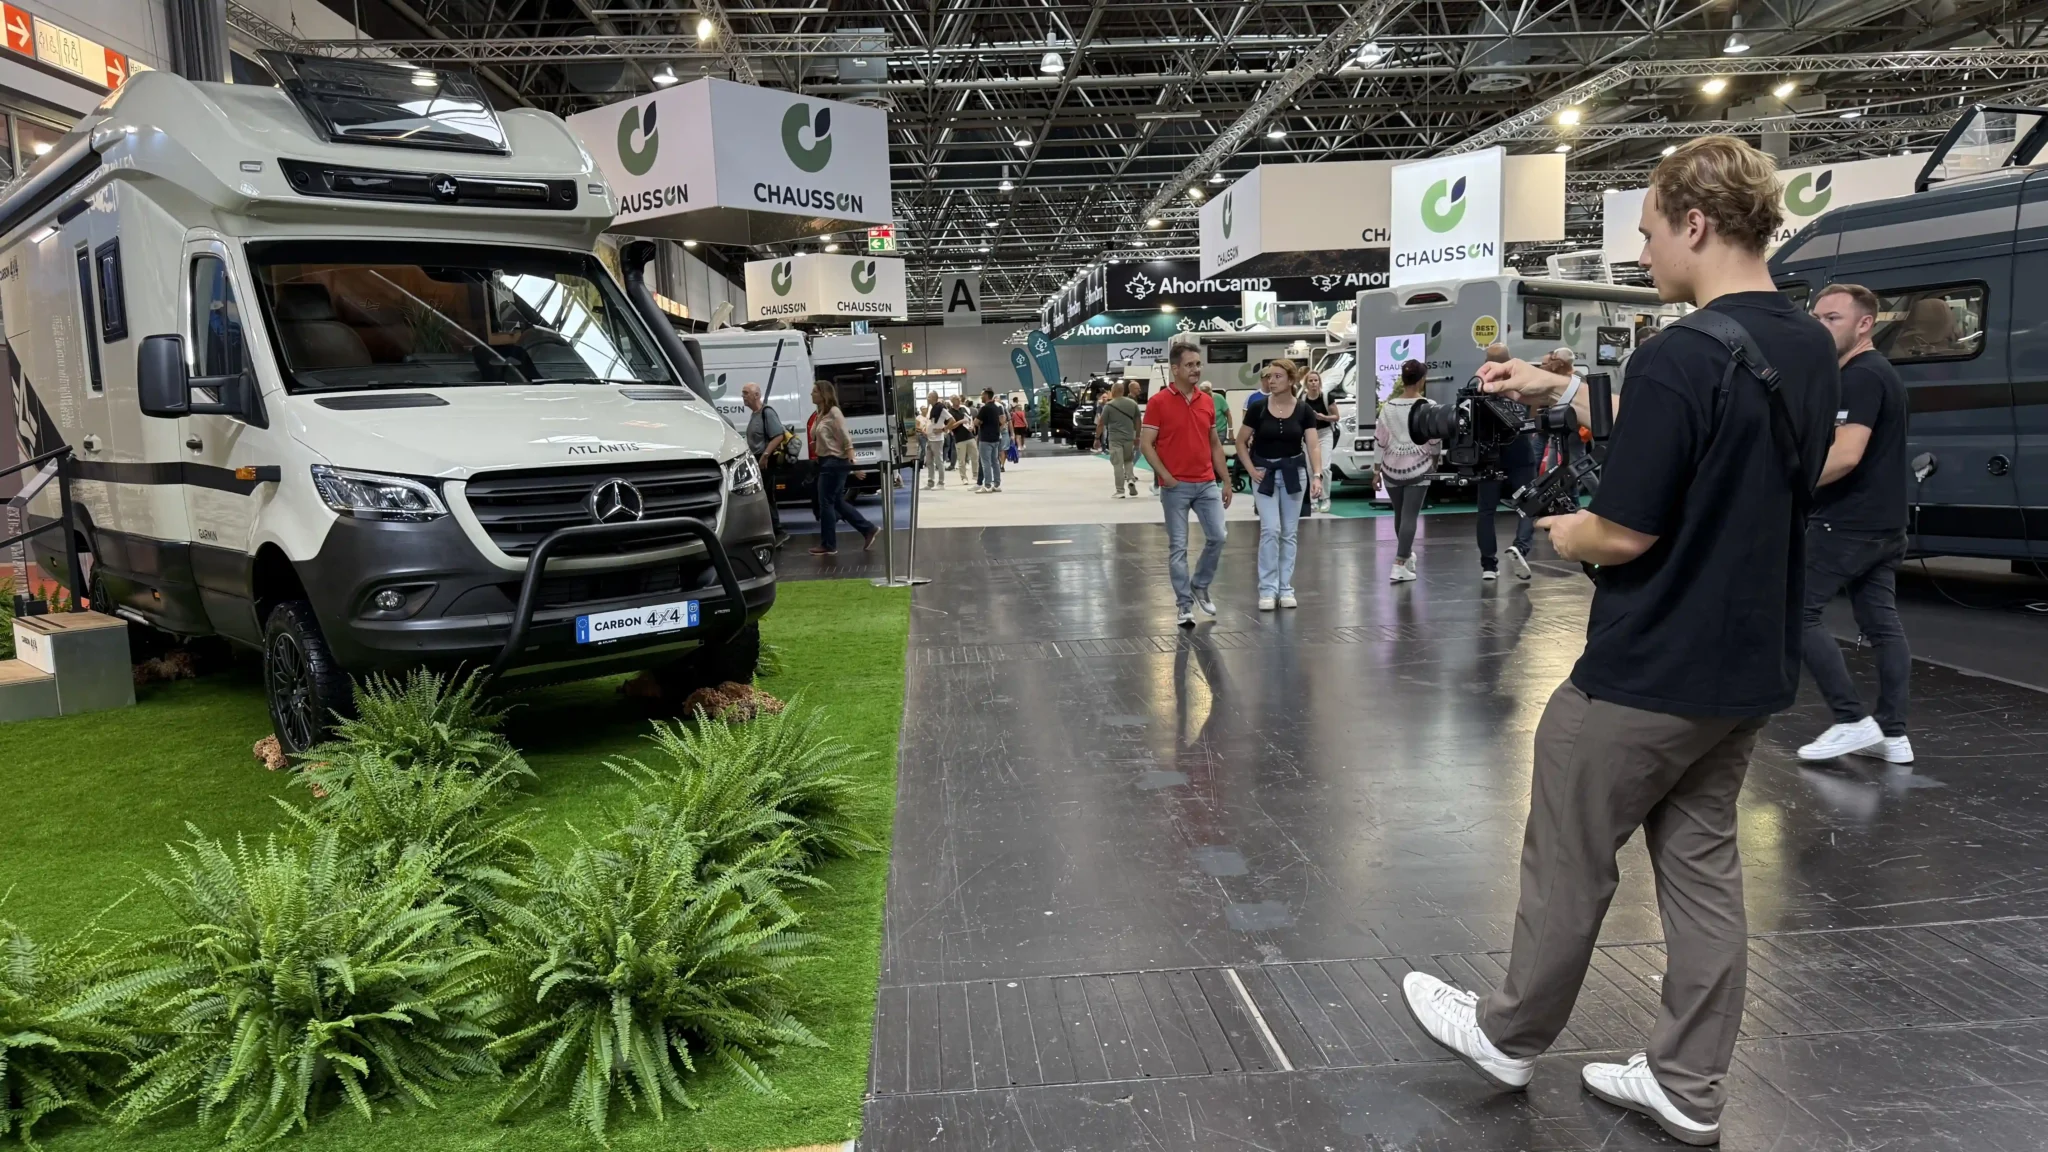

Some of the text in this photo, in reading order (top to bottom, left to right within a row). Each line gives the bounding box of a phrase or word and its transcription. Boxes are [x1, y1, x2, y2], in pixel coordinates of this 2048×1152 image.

[616, 184, 688, 216] AUSSON
[753, 182, 863, 213] CHAUSSON
[1395, 242, 1493, 267] CHAUSSON
[1158, 277, 1271, 294] AhornCamp
[947, 278, 976, 312] A
[760, 302, 806, 316] CHAUSSON
[837, 301, 892, 313] CHAUSSON
[1077, 324, 1150, 336] AhornCamp
[1140, 346, 1163, 355] Polar
[848, 427, 885, 435] HAUSSON
[568, 443, 640, 455] ATLANTIS
[594, 616, 642, 631] CARBON
